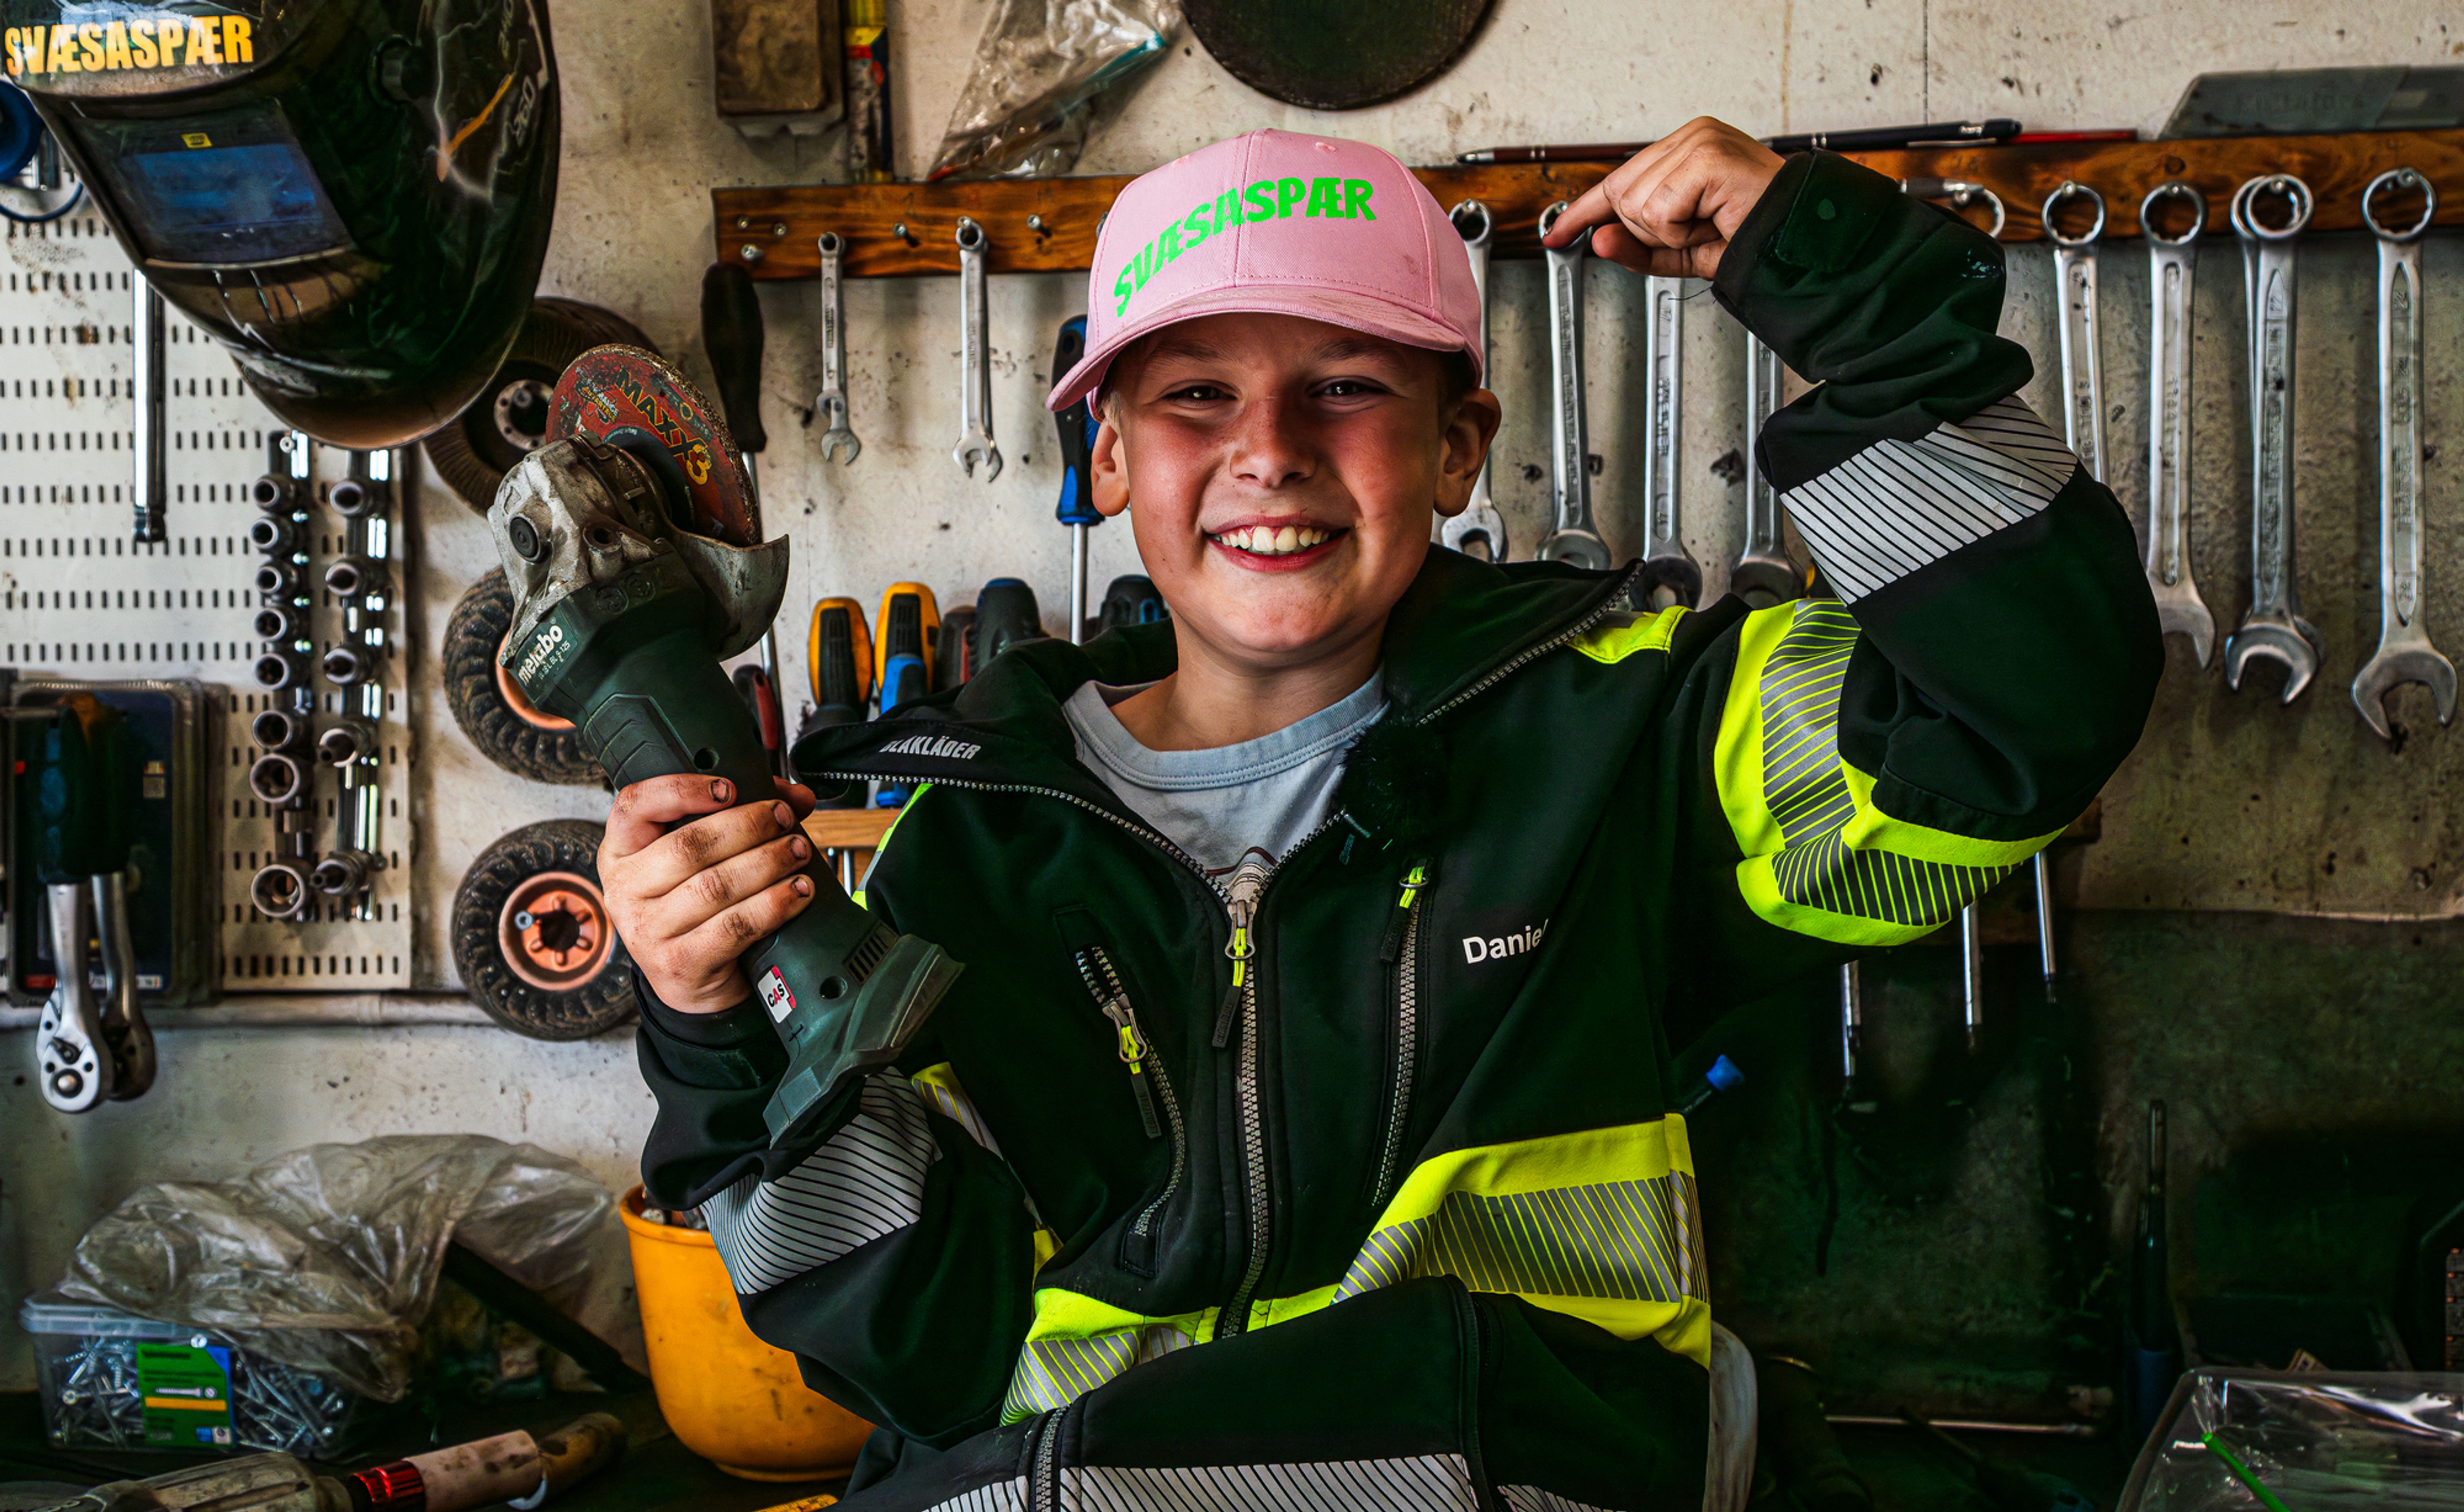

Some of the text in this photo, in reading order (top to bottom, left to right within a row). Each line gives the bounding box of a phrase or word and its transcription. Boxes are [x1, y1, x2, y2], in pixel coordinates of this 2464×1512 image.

[4, 15, 254, 76] SVÆSASPÆR
[1114, 177, 1377, 318] SVÆSASPÆR
[614, 365, 712, 485] MAXX3
[518, 625, 563, 686] metabo
[767, 983, 785, 1007] CAS
